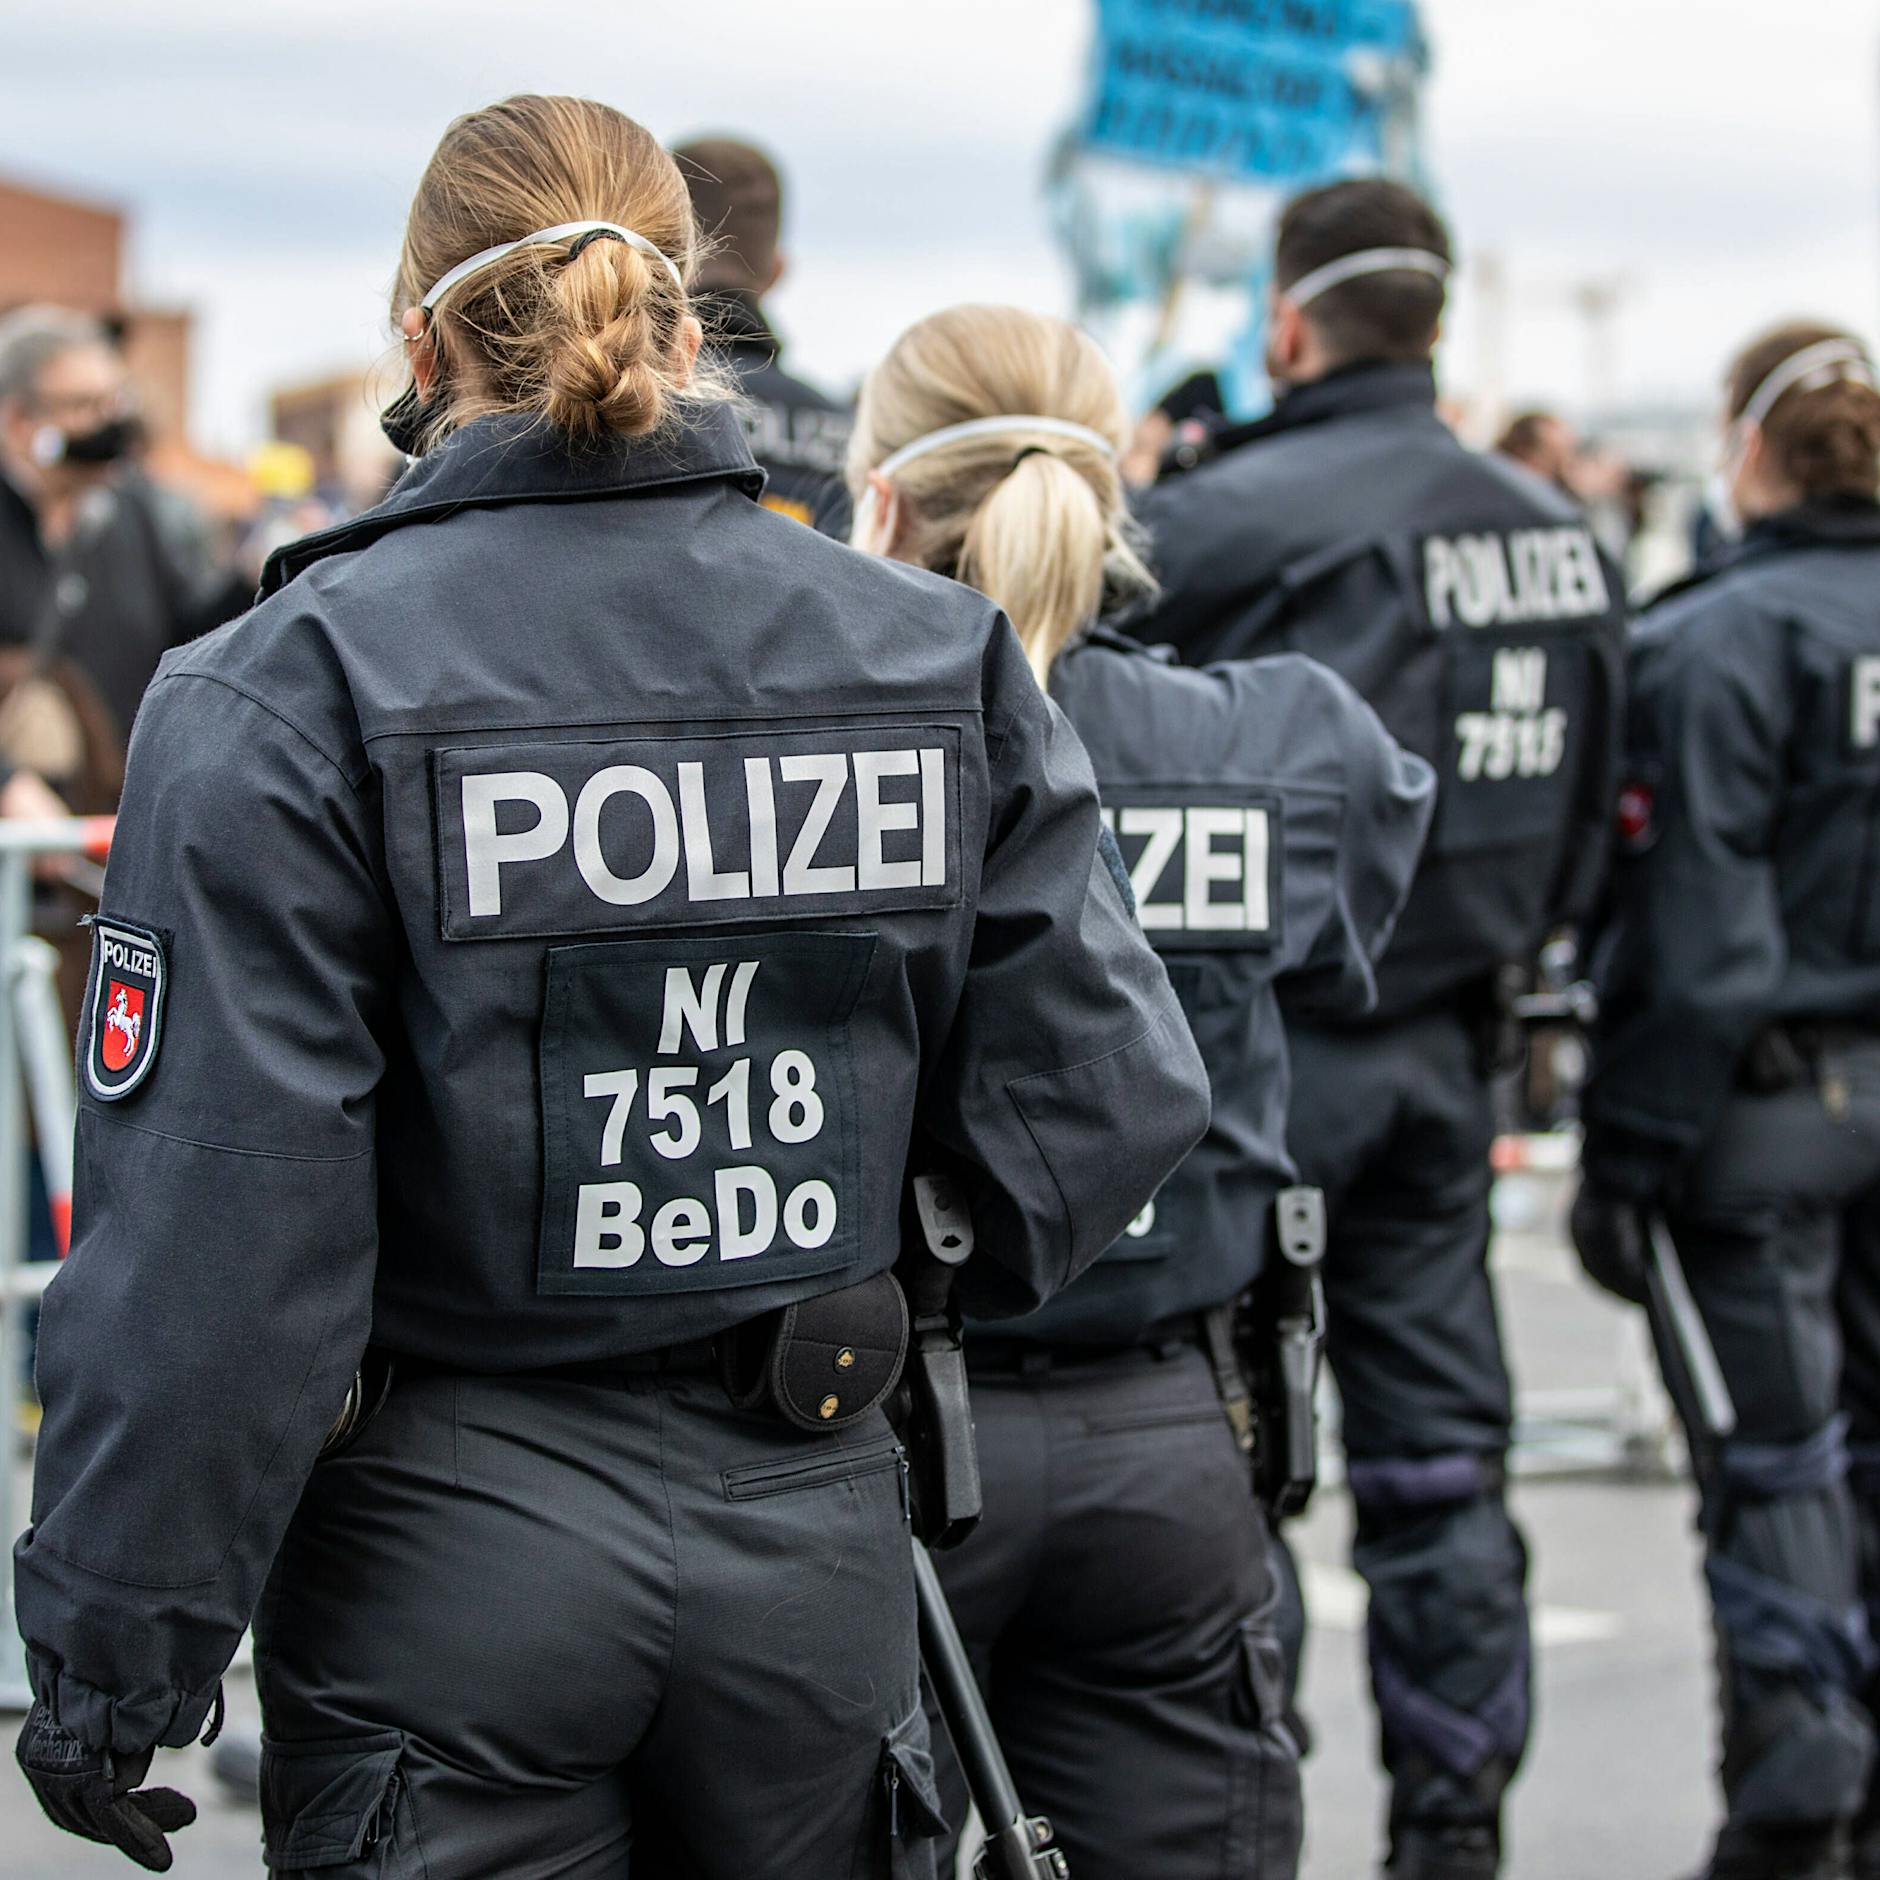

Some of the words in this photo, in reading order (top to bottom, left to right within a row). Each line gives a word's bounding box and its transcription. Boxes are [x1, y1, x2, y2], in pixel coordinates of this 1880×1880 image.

[1424, 527, 1610, 629] POLIZEI
[461, 748, 946, 917] POLIZEI
[1100, 806, 1269, 930] ZEI
[104, 940, 157, 979] POLIZEI
[657, 961, 760, 1054] NI
[583, 1049, 824, 1167] 7518
[573, 1165, 837, 1269] BeDo
